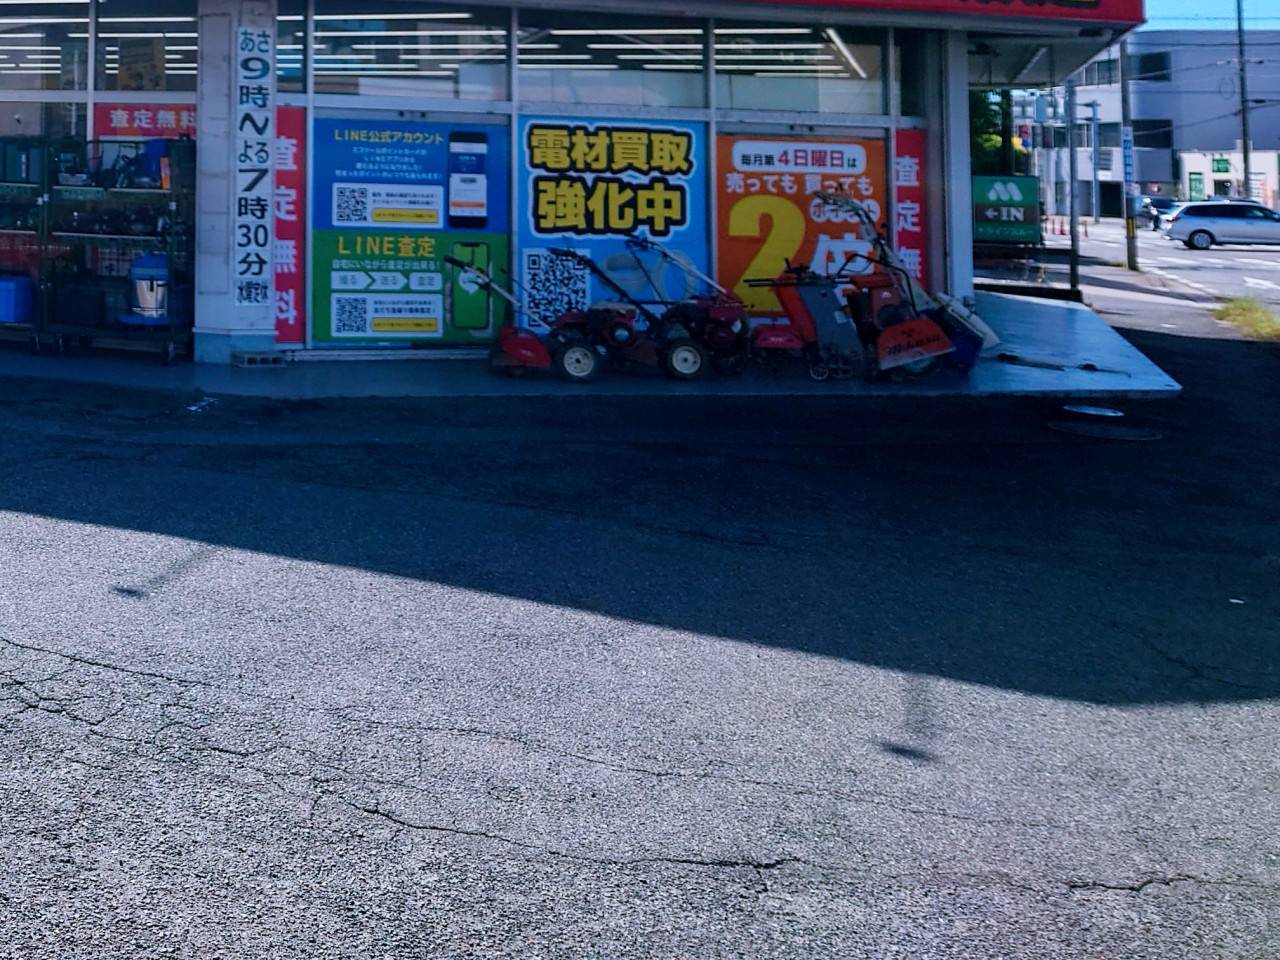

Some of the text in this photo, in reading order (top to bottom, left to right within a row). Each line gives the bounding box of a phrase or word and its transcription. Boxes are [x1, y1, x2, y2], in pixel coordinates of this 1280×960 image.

[334, 129, 445, 144] LINE公式アカウント
[530, 127, 690, 172] 電材買取
[725, 173, 798, 193] 売っても
[538, 179, 682, 231] 強化中
[999, 206, 1025, 222] IN
[338, 235, 436, 257] LINE査定
